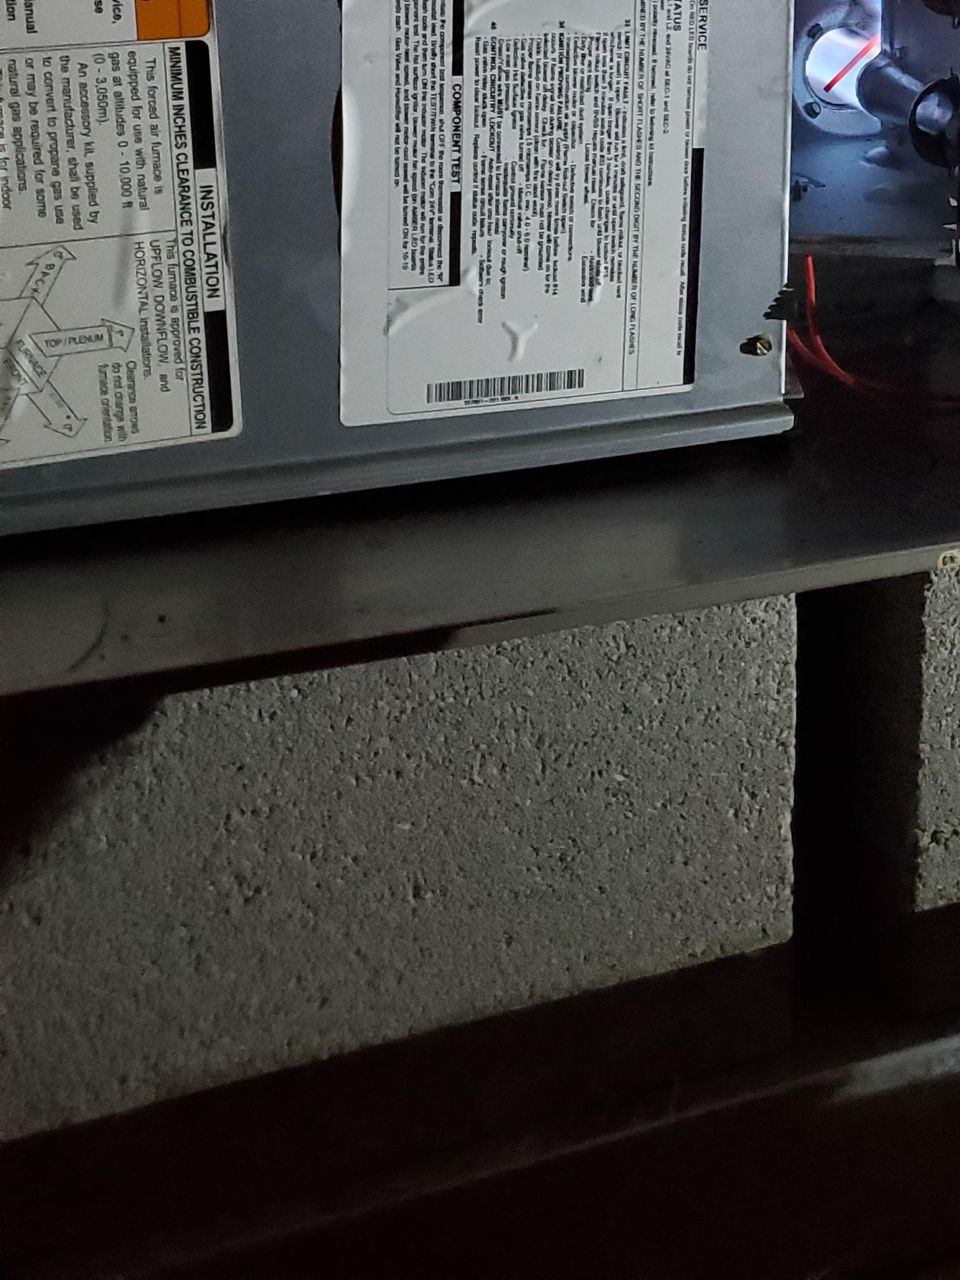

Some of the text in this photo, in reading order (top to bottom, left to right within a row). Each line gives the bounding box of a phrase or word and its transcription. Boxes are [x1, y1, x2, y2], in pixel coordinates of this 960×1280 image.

[697, 0, 709, 51] SERVICE
[7, 59, 21, 97] natural
[77, 62, 89, 78] An
[109, 52, 121, 72] gas
[126, 51, 142, 101] equipped
[145, 58, 158, 82] This
[113, 75, 124, 87] at
[8, 100, 21, 122] gas
[76, 81, 91, 137] accessory
[114, 90, 128, 137] altitudes
[132, 105, 144, 120] for
[147, 85, 160, 119] forced
[24, 58, 46, 218] or may be required for some
[43, 56, 64, 224] to convert to propane gas use
[60, 56, 84, 230] the manufacturer, shall be used
[133, 123, 143, 143] use
[150, 123, 161, 137] air
[451, 83, 461, 184] COMPONENT TEST
[82, 161, 98, 207] supplied
[136, 173, 150, 211] natural
[154, 185, 165, 194] is
[86, 210, 100, 224] by
[122, 200, 133, 209] ft
[165, 238, 178, 260] This
[168, 46, 207, 430] MINIMUM INCHES CLEARANCE TO COMBUSTIBLE CONSTRUCTION
[199, 185, 220, 299] INSTALLATION
[134, 241, 154, 381] HORIZONTAL installations.
[170, 304, 181, 313] is
[17, 339, 47, 377] FURNACE
[169, 316, 185, 364] approved
[158, 373, 170, 392] and
[174, 366, 186, 381] for
